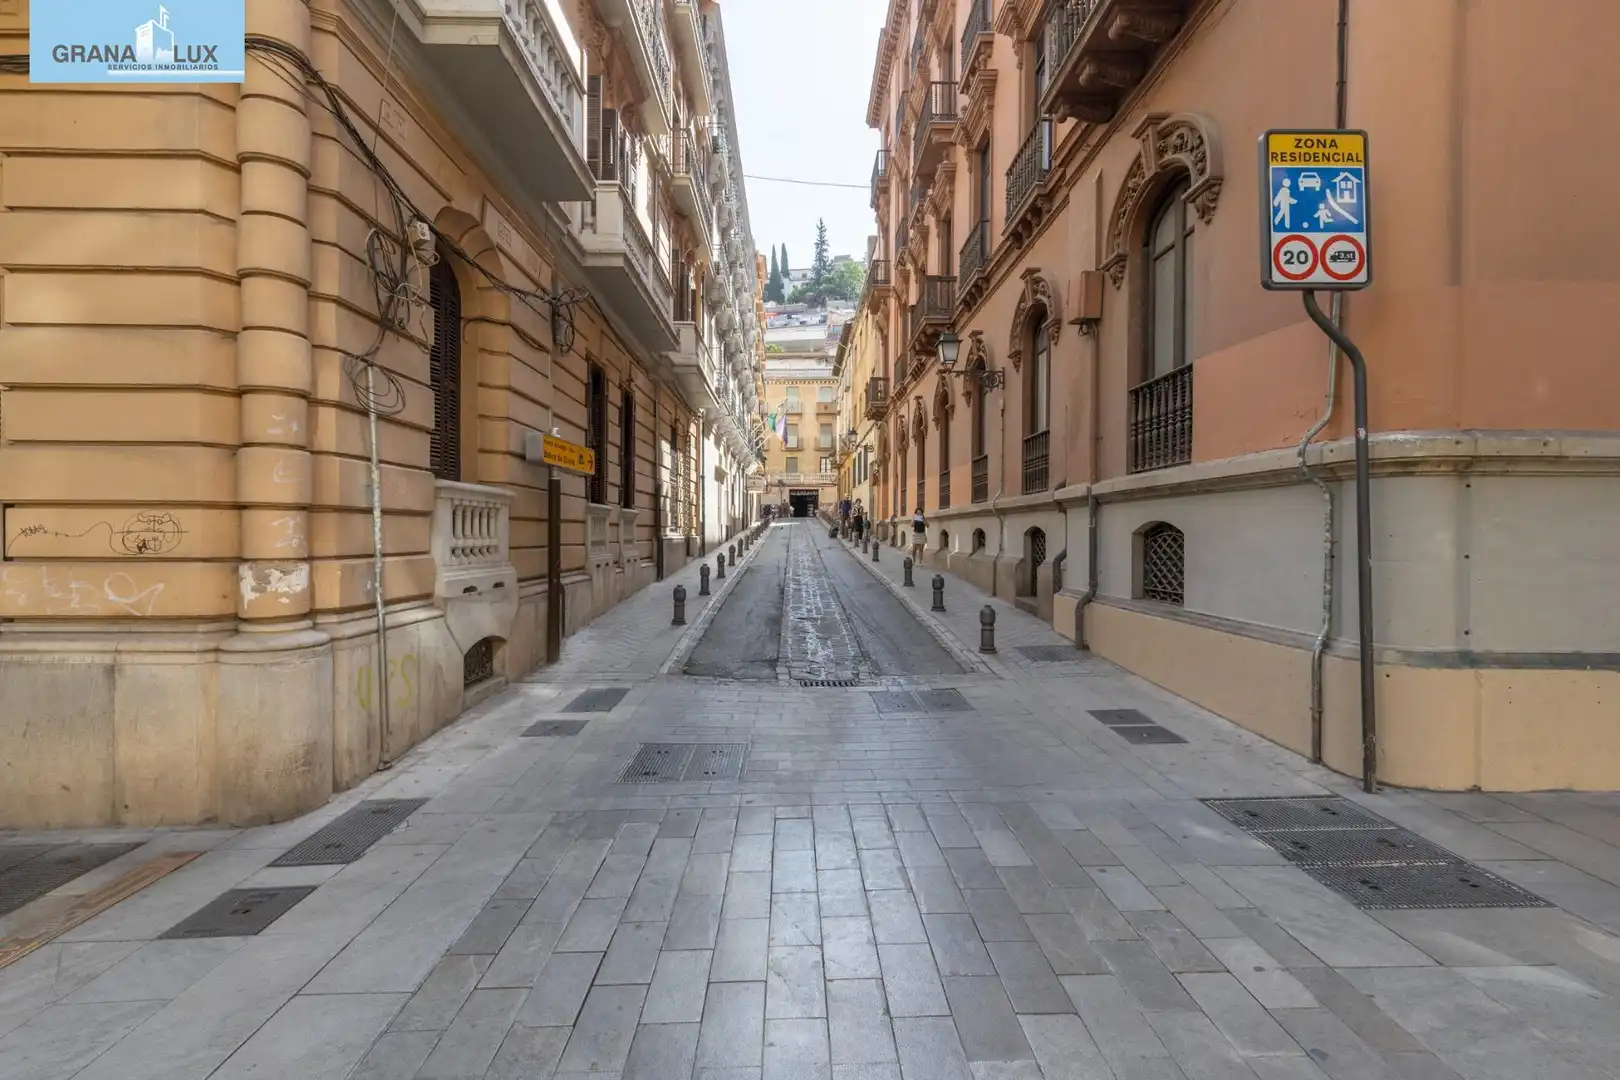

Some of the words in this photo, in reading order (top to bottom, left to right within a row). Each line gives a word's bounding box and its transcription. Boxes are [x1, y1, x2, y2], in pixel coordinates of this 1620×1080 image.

[1294, 138, 1339, 149] ZONA
[1271, 151, 1363, 163] RESIDENCIAL
[1283, 250, 1309, 265] 20
